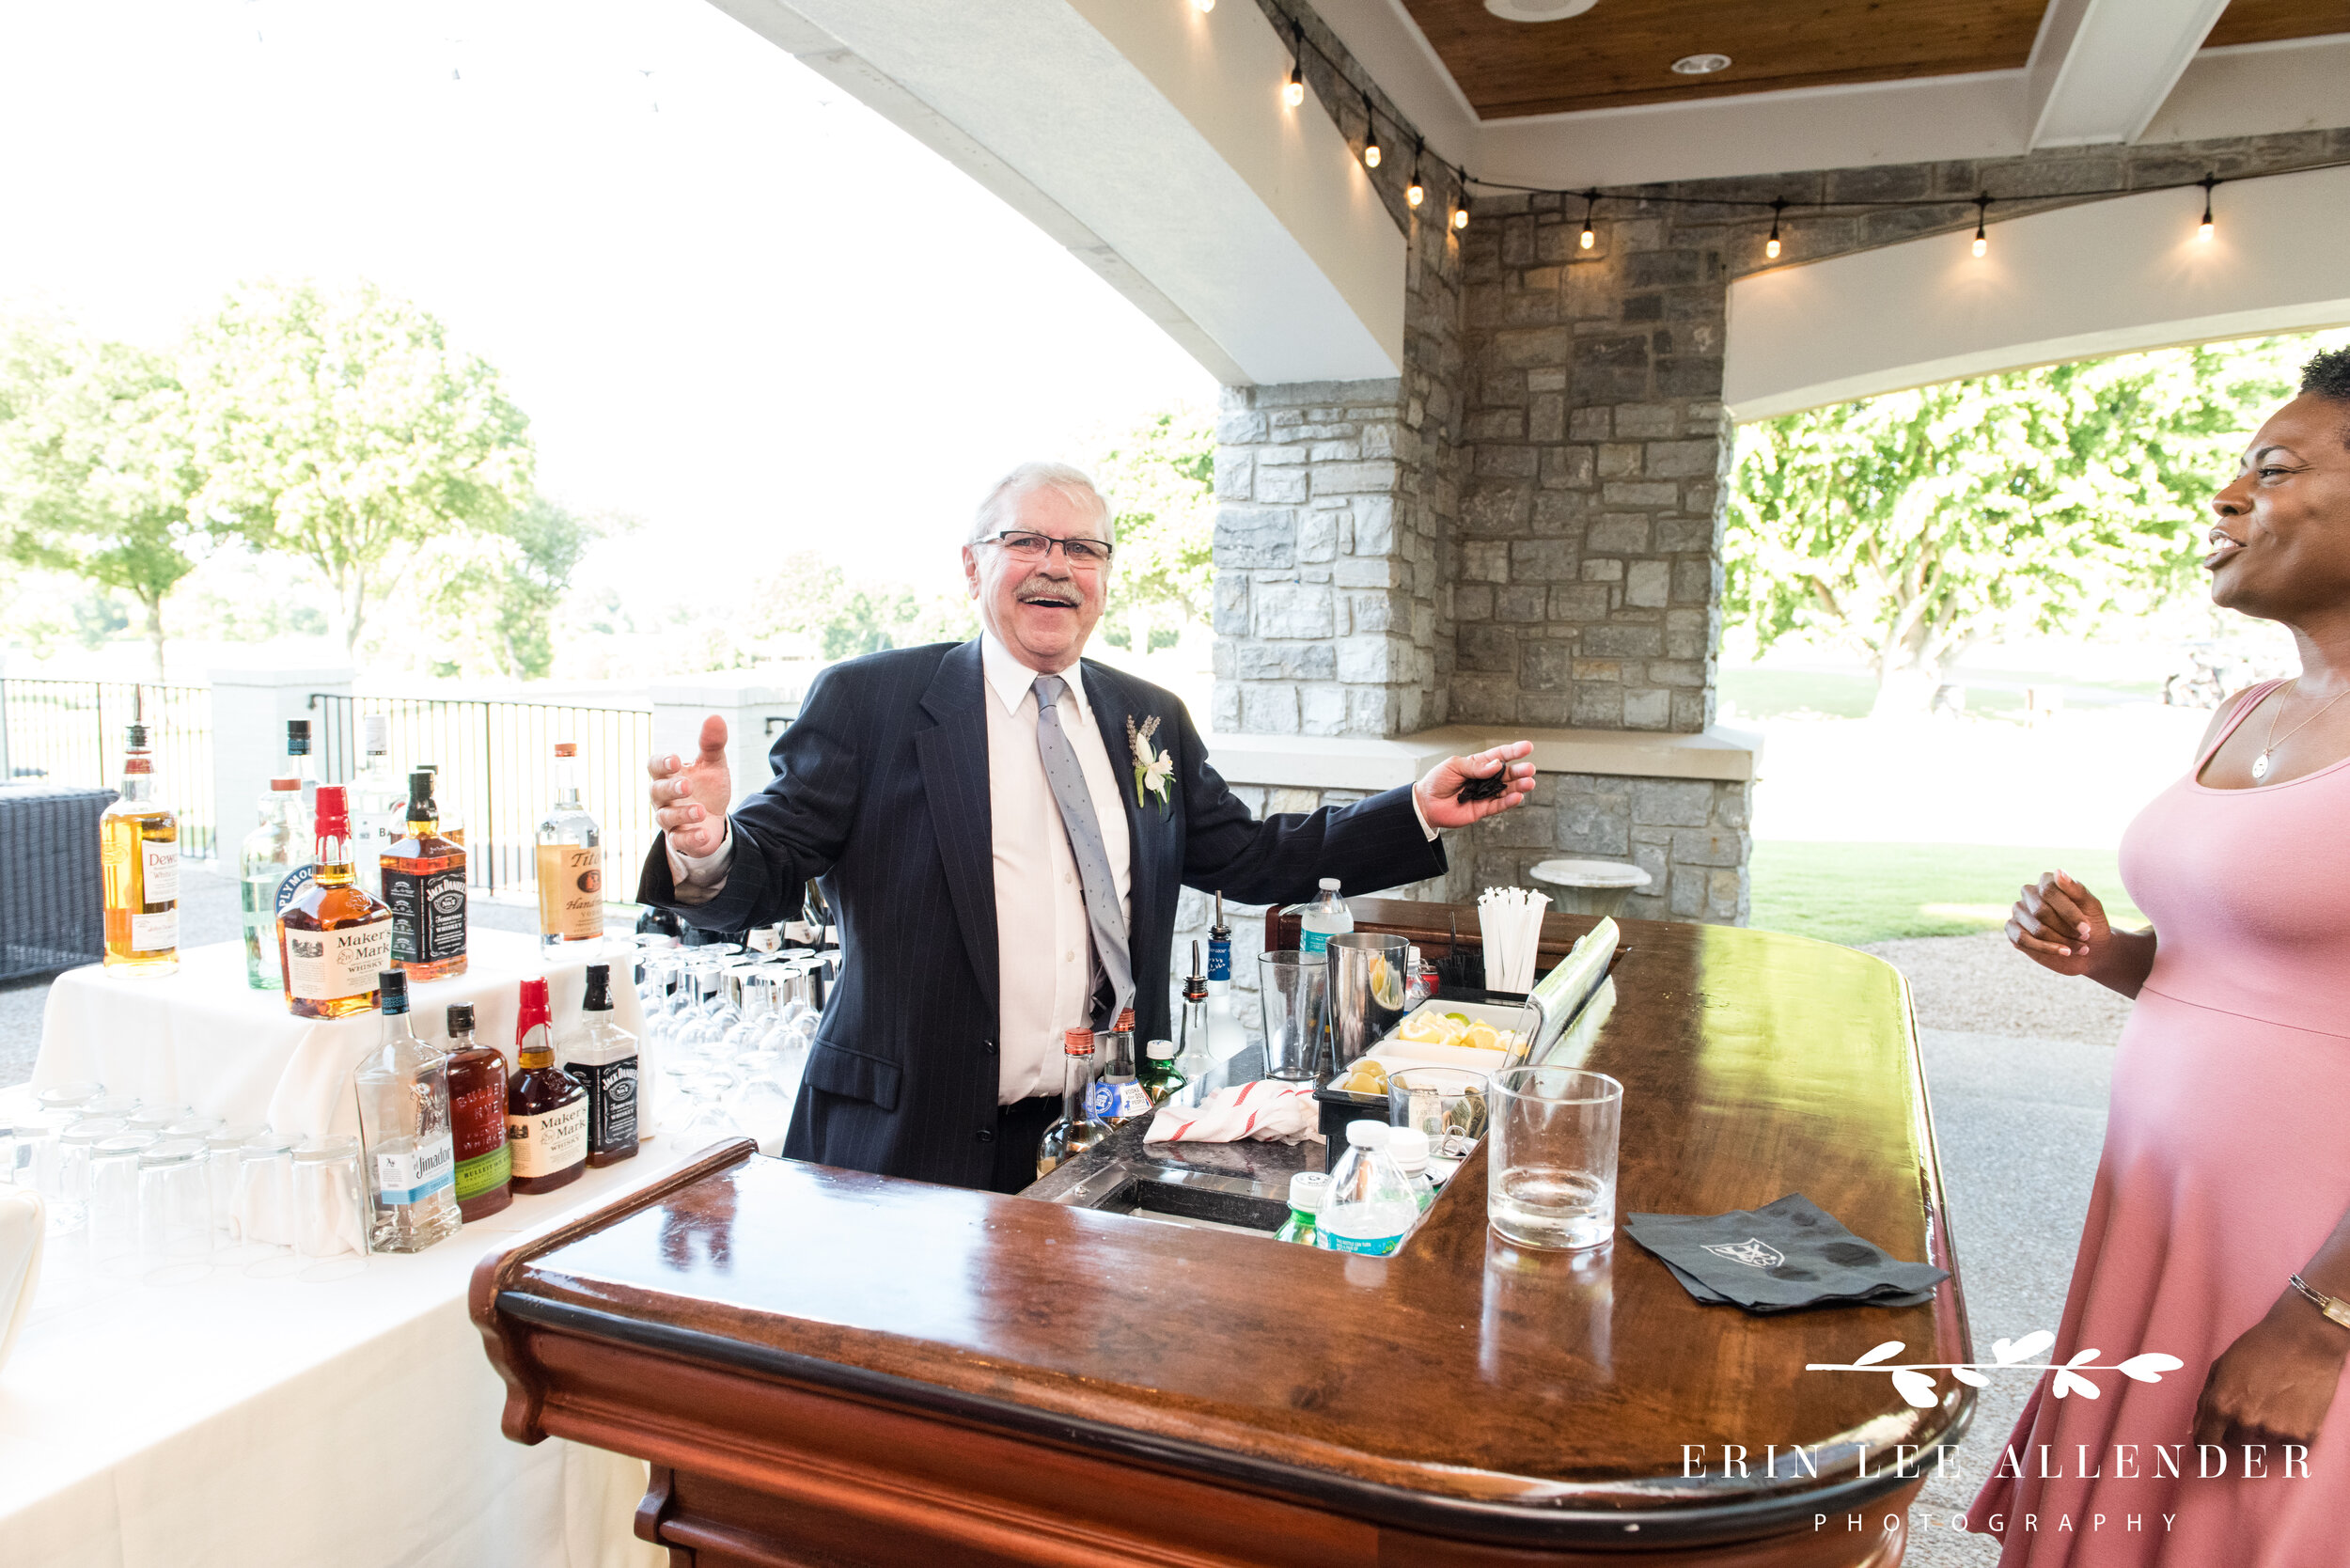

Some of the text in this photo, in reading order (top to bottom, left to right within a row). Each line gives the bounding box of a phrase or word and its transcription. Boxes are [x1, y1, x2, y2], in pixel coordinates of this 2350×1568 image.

[337, 928, 392, 949] Maker's
[355, 942, 390, 961] Mark
[348, 960, 384, 973] WHISKY
[540, 1105, 587, 1130] Maker's
[556, 1119, 587, 1139] Mark
[415, 1147, 451, 1179] Jimador
